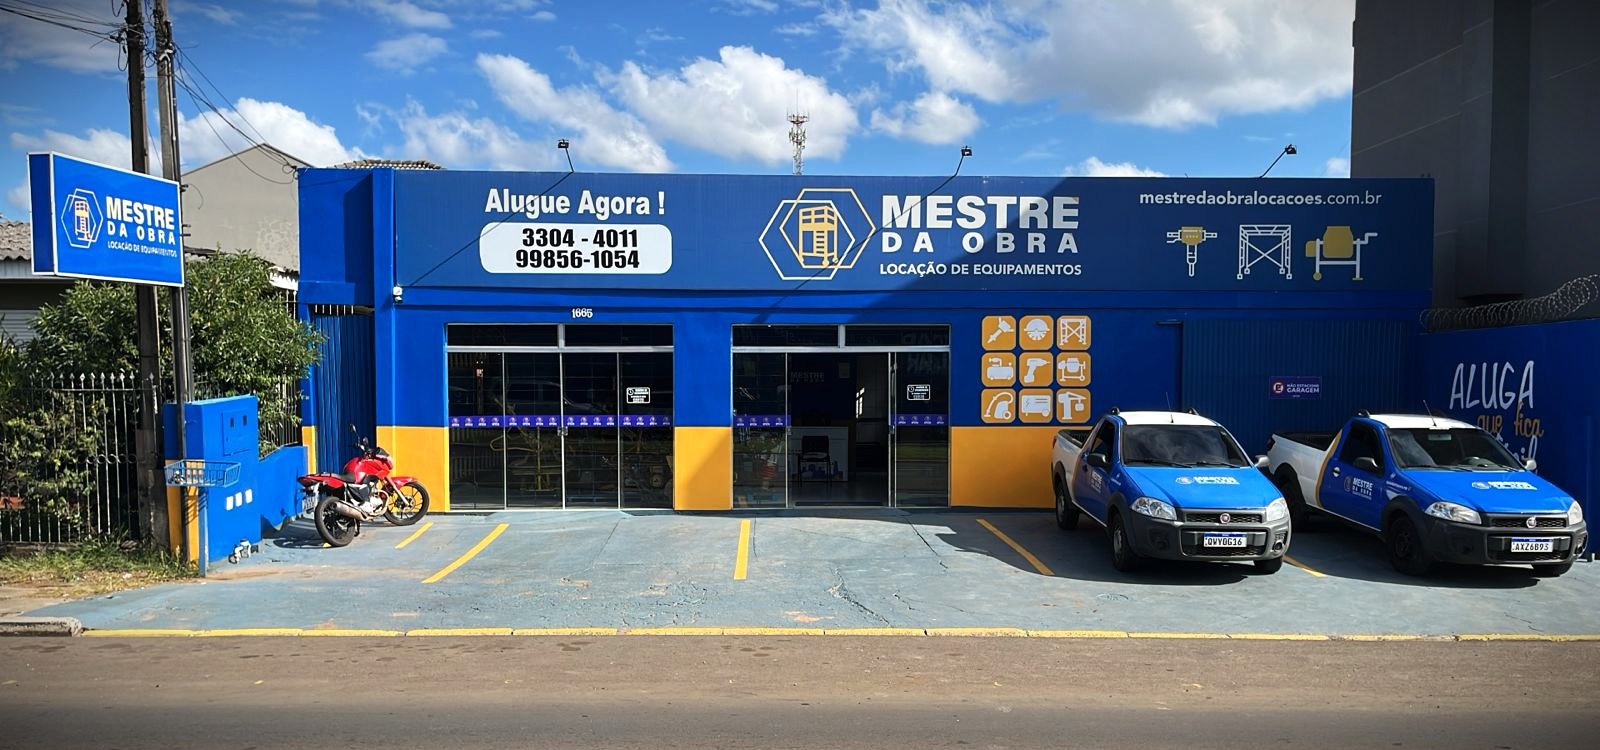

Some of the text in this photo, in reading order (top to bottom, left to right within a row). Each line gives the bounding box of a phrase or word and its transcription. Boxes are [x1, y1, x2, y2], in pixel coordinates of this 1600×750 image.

[485, 188, 665, 221] Alugue Agora !
[1139, 190, 1382, 205] mestredaobralocacoes.com.br
[106, 196, 175, 230] MESTRE
[882, 195, 1080, 229] MESTRE
[107, 220, 175, 244] DA OBRA
[522, 228, 575, 247] 3304
[593, 229, 638, 248] 4011
[882, 232, 1078, 254] DA OBRA
[516, 249, 640, 269] 99856-1054
[880, 261, 1082, 277] LOCAÇÃO DE EQUIPAMENTOS
[571, 308, 594, 319] 1665
[1449, 360, 1535, 410] ALUGA
[1513, 403, 1545, 438] fica
